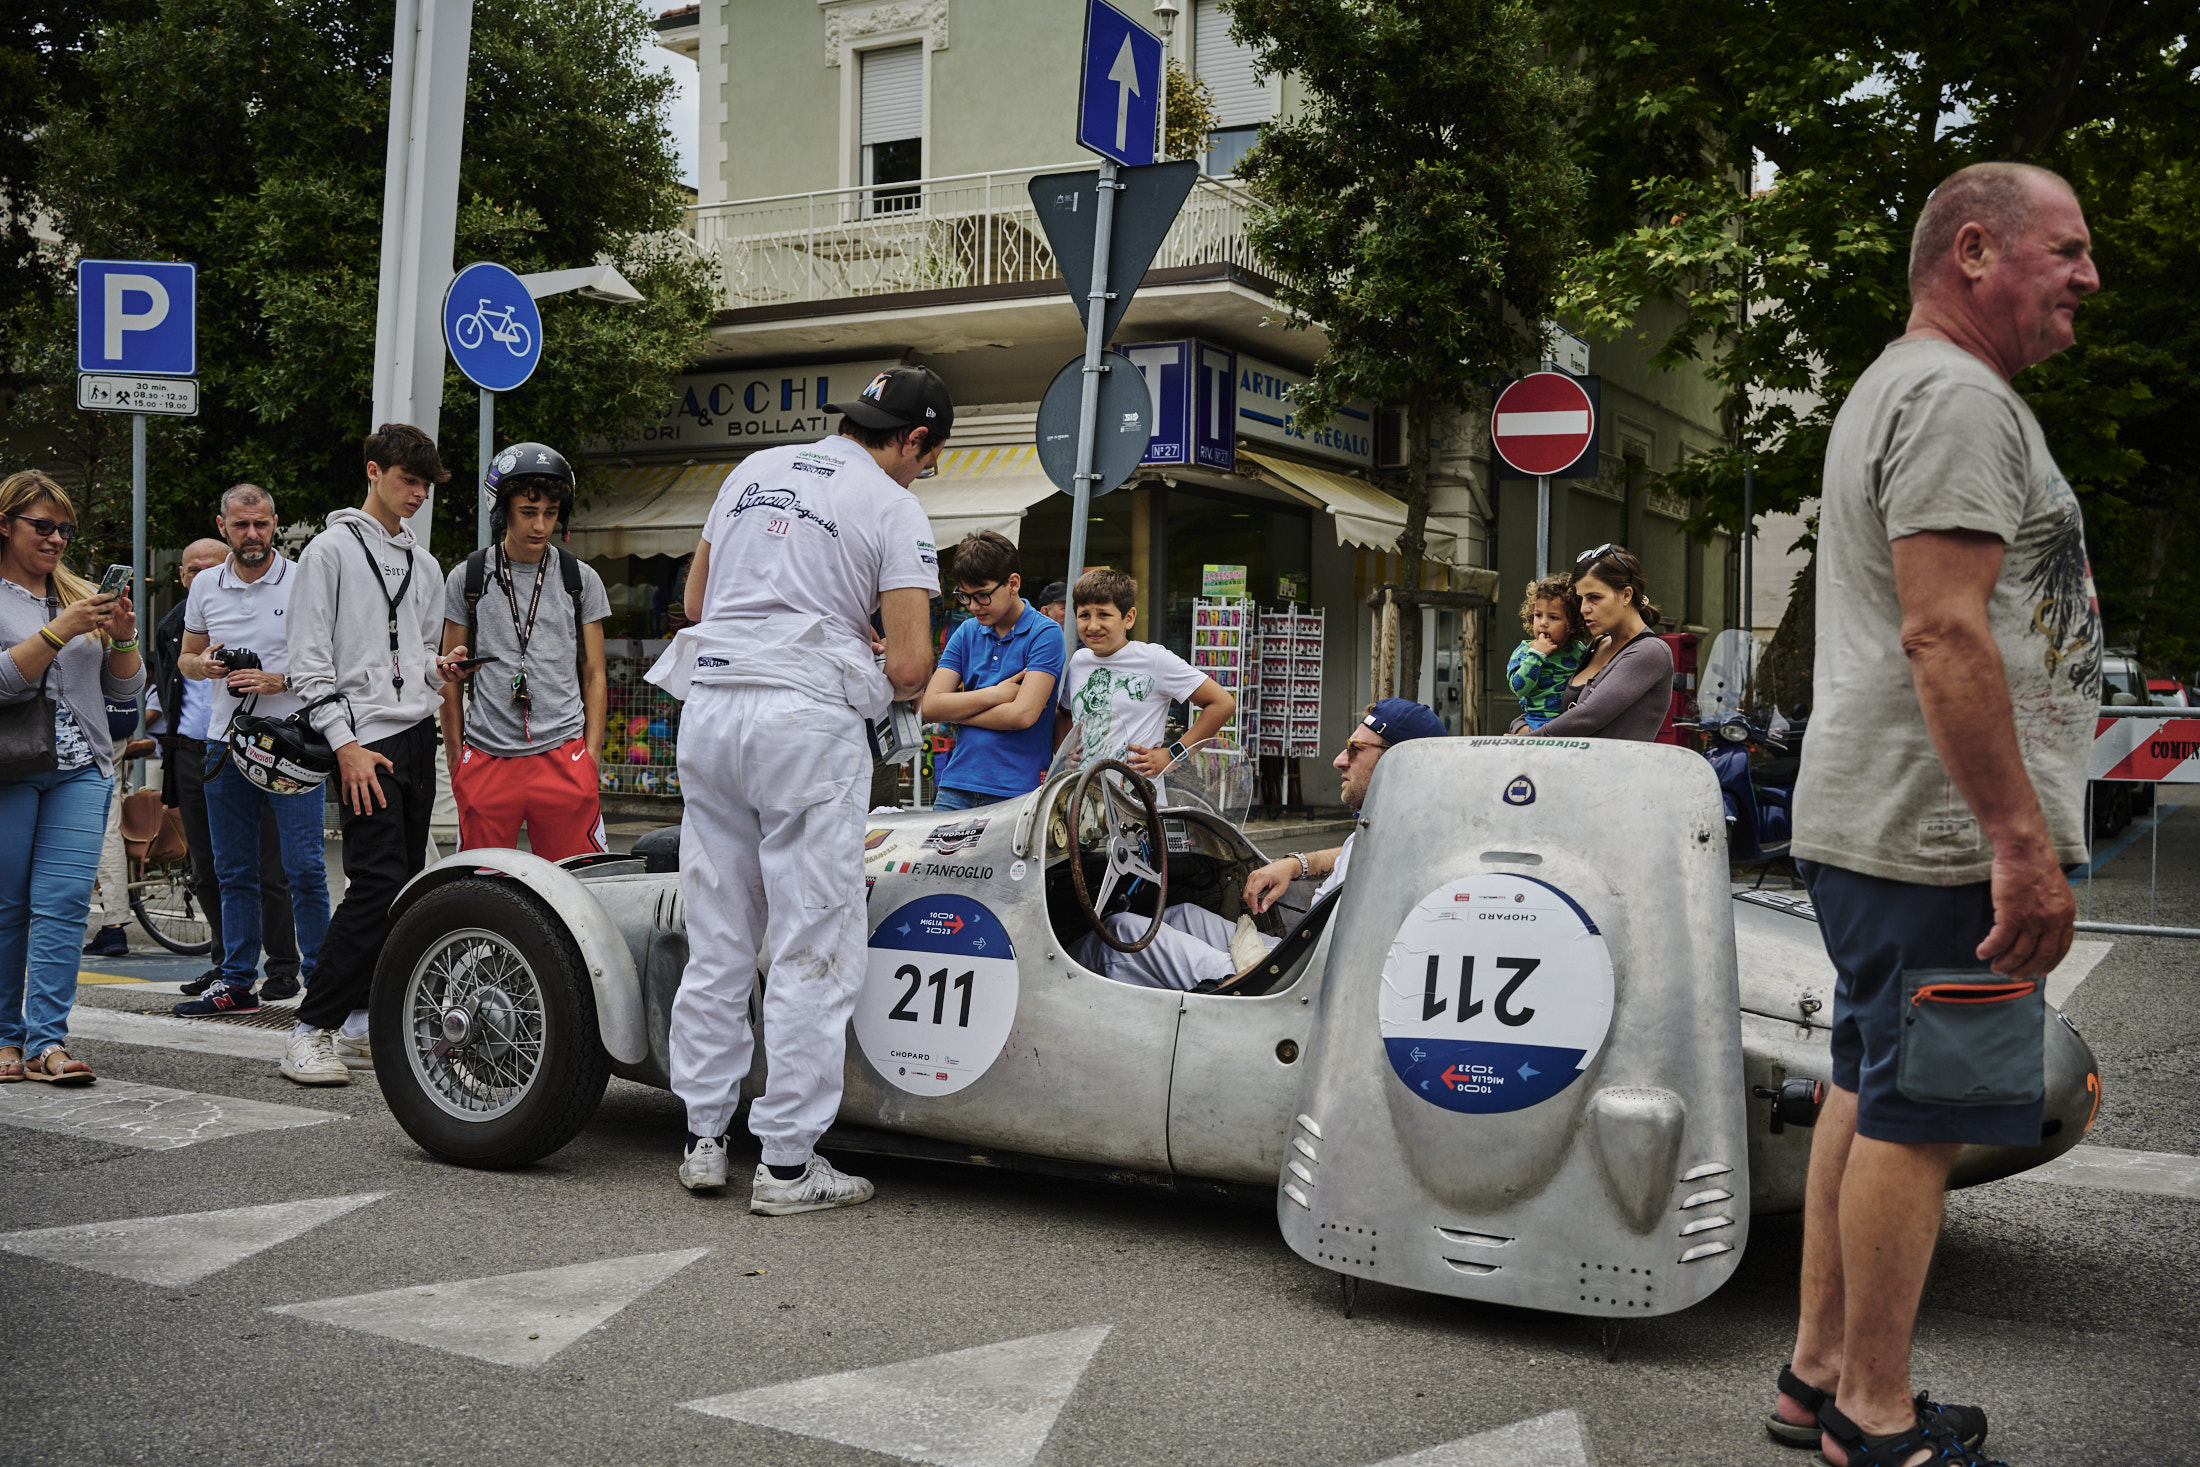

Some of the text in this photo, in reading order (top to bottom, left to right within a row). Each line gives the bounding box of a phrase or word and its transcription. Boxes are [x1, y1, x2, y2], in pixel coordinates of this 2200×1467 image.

[104, 273, 170, 360] P
[1571, 353, 1586, 374] Trento
[136, 382, 148, 390] 30
[133, 391, 159, 399] 08.30
[166, 393, 188, 401] 12.30
[1202, 348, 1229, 440] T
[134, 400, 157, 408] 15.00
[165, 401, 187, 410] 19.00
[697, 408, 714, 427] &
[728, 417, 827, 436] BOLLATI
[1314, 425, 1369, 457] REGALO
[1200, 445, 1214, 460] RIV.
[726, 482, 796, 517] Lancia
[767, 519, 789, 535] 211
[105, 704, 137, 715] Champion
[1470, 738, 1590, 750] GalvanoTechnik
[938, 829, 977, 838] CHOPARD
[911, 862, 922, 874] F.
[925, 863, 993, 880] TANFOGLIO
[1479, 913, 1537, 922] CHOPARD
[926, 927, 951, 935] 2023
[888, 964, 974, 1027] 211
[1422, 955, 1541, 1026] 211
[890, 1050, 930, 1061] CHOPARD
[1458, 1064, 1494, 1074] 2023
[1472, 1075, 1504, 1085] MIGLIA
